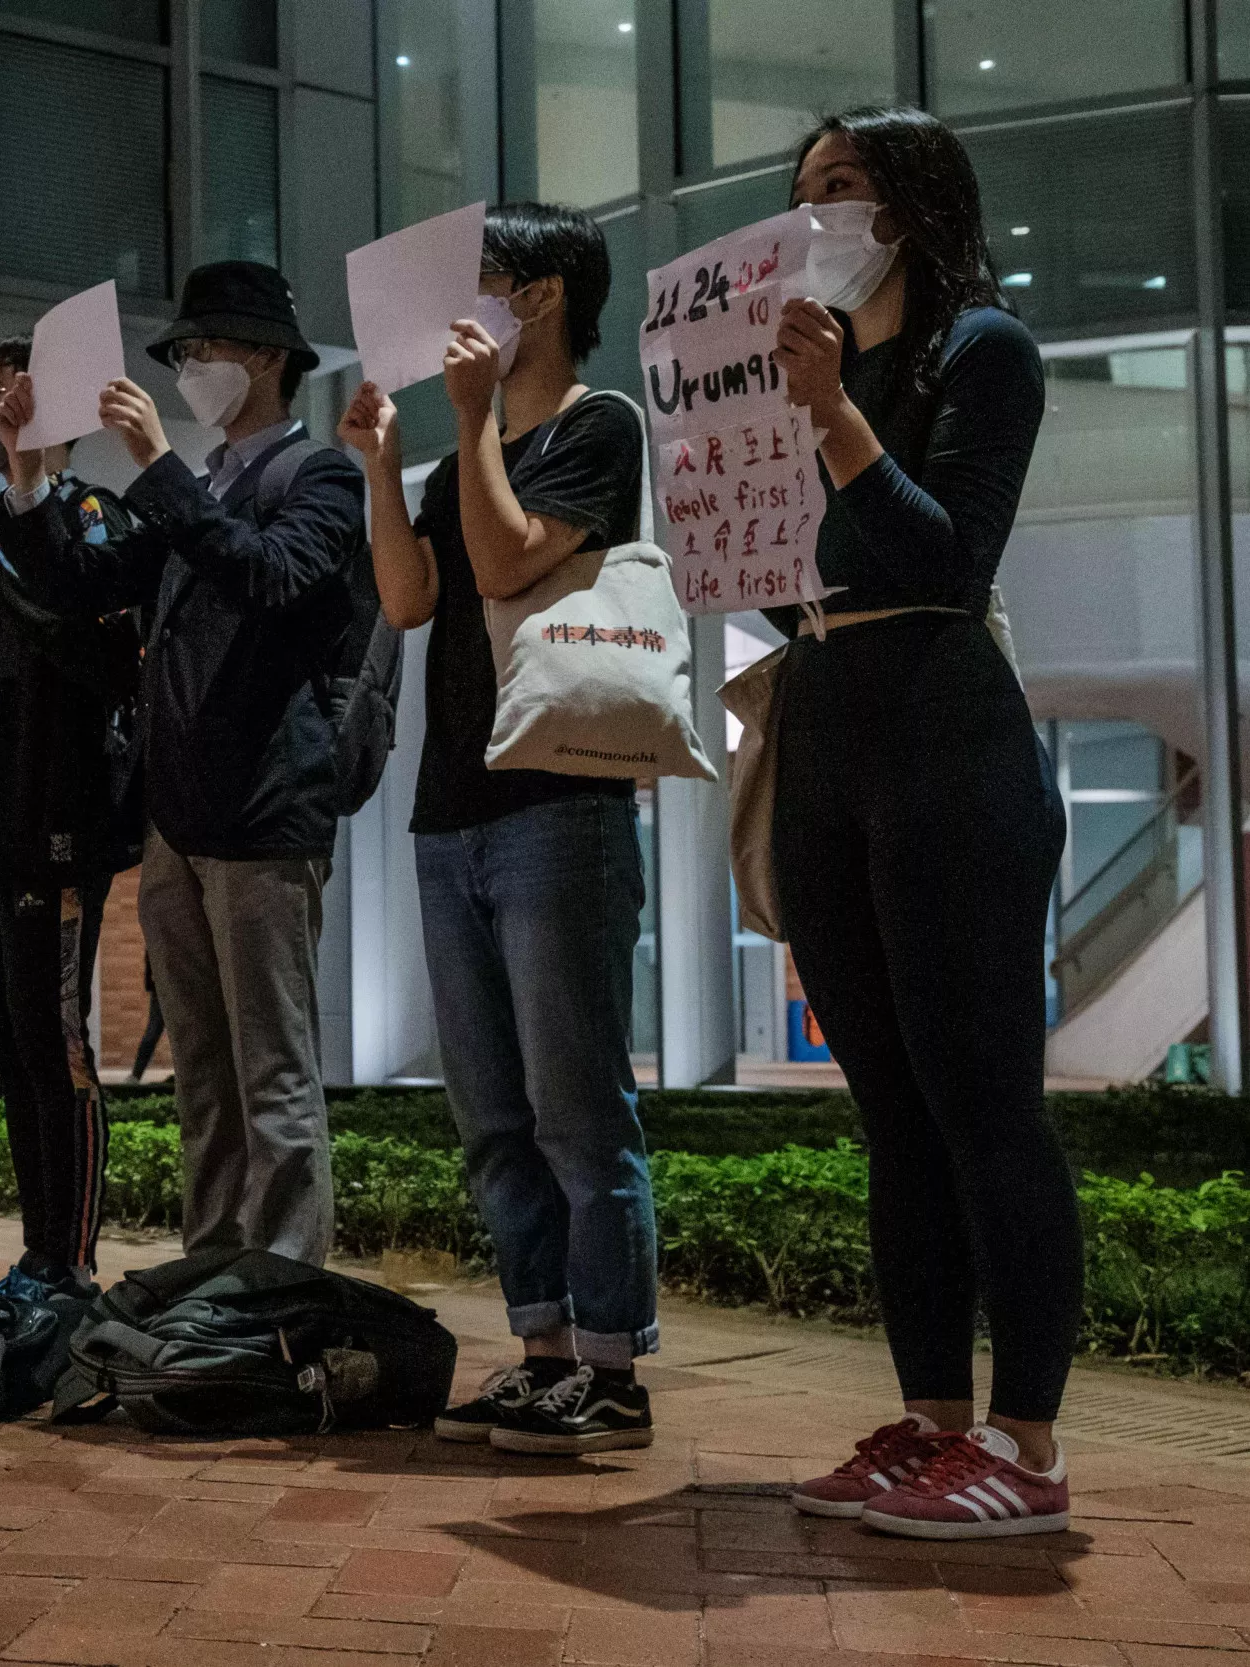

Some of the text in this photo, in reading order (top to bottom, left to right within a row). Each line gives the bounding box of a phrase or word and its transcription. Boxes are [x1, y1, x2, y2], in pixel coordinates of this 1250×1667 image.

[646, 261, 730, 333] 11.24
[748, 296, 769, 326] 10
[649, 350, 780, 415] Urumqi
[686, 568, 723, 607] Life
